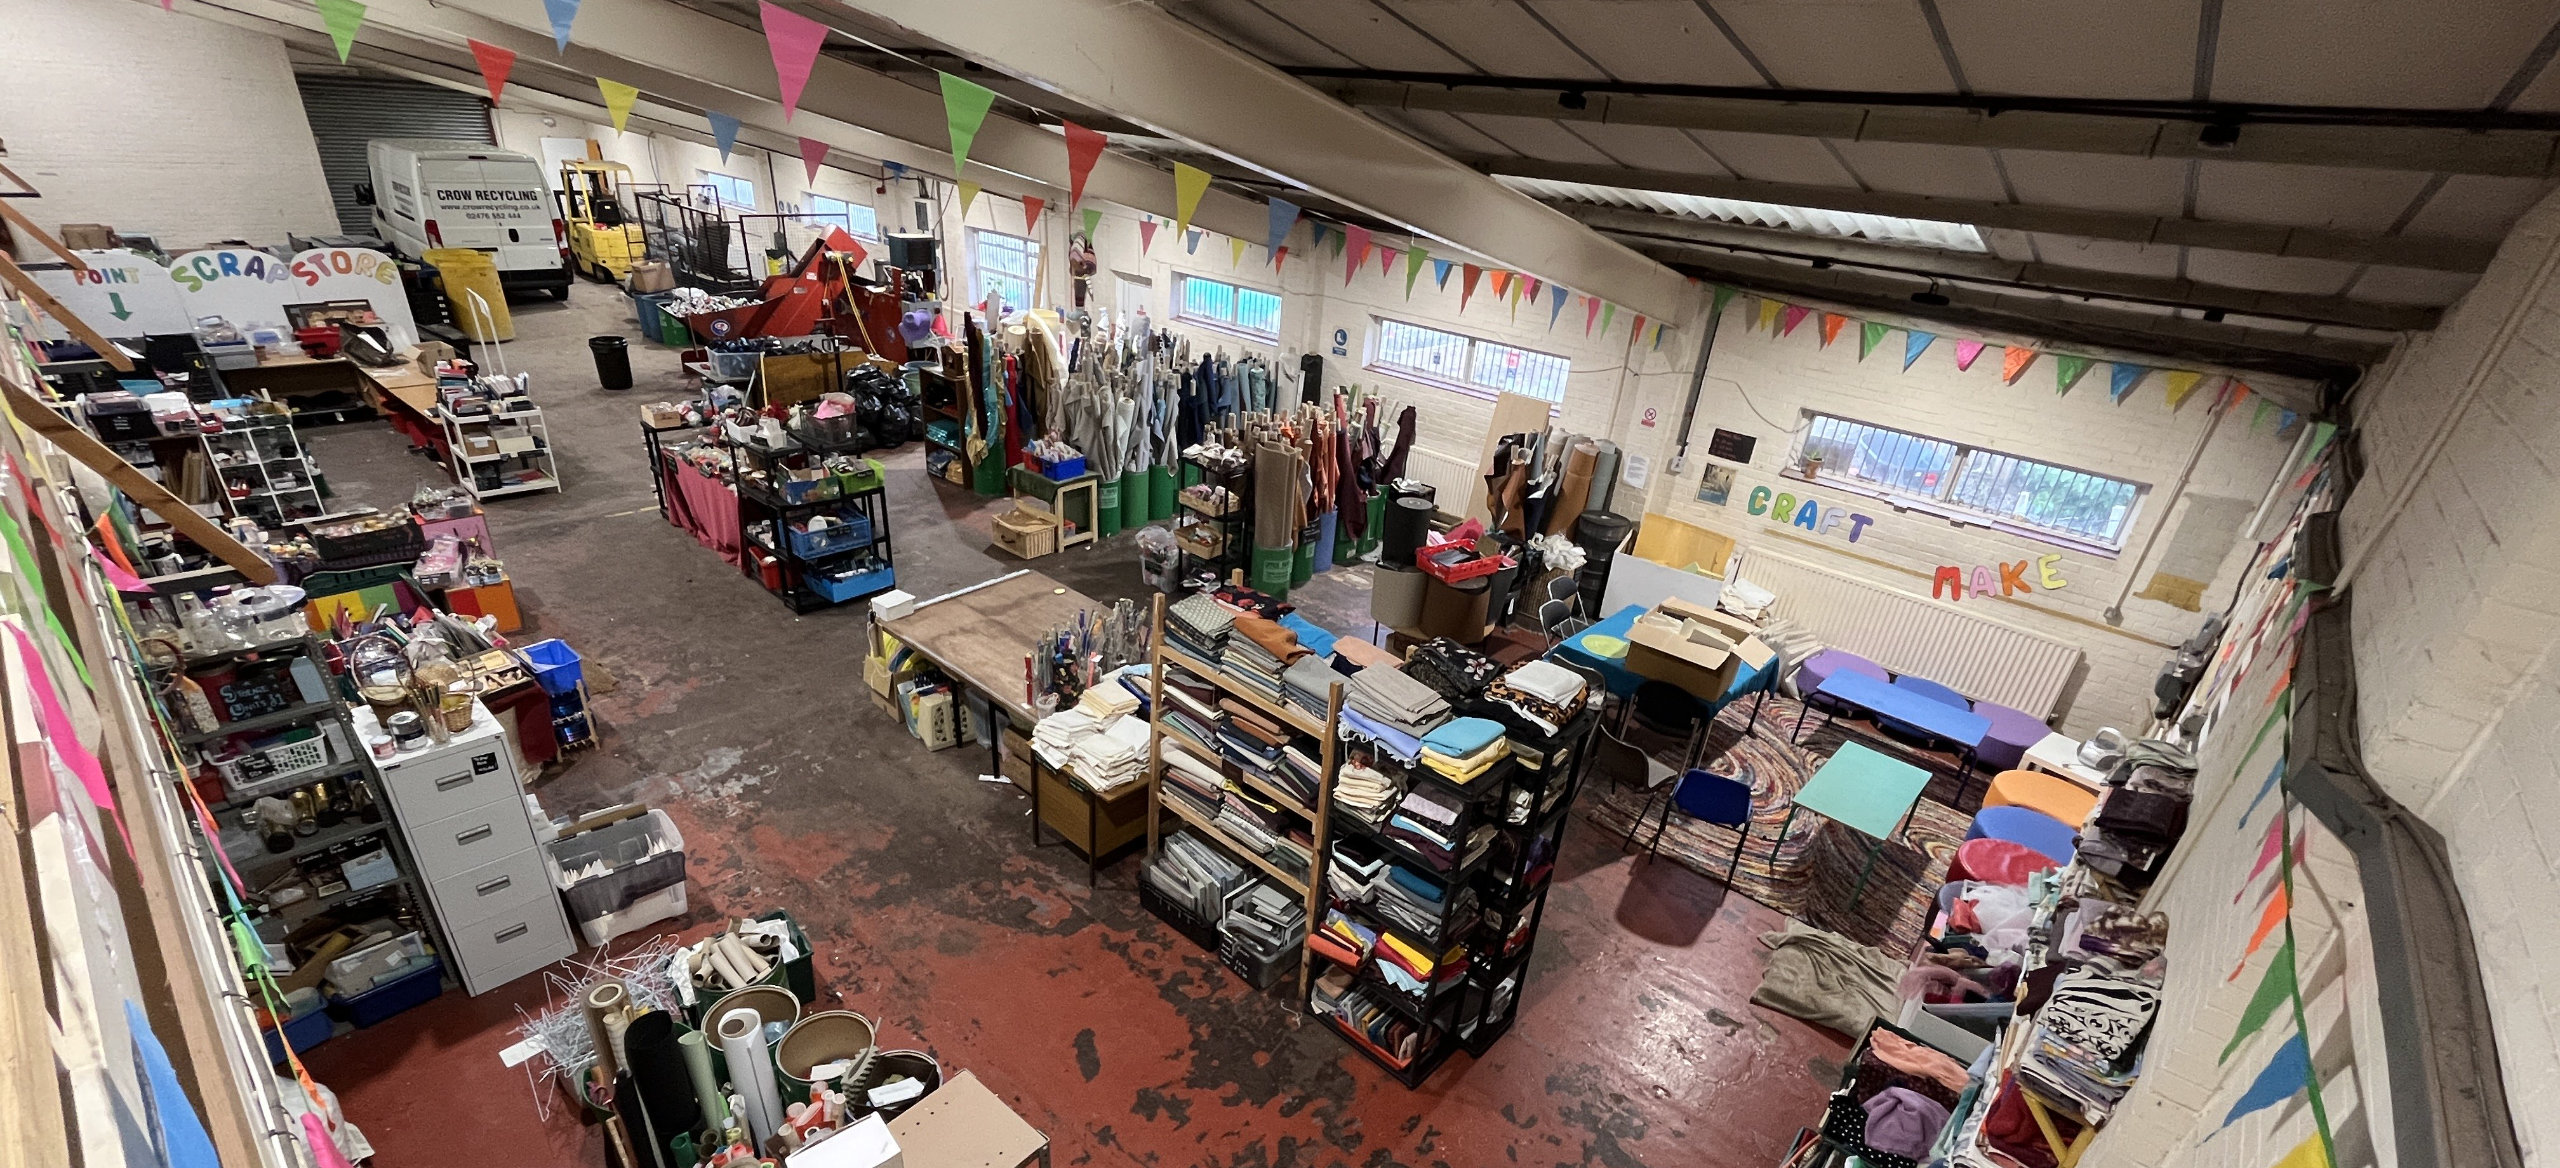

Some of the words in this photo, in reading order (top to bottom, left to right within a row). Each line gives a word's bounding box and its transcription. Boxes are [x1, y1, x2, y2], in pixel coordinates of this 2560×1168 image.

[437, 190, 472, 201] CROW
[475, 190, 538, 201] RECYCLING
[72, 267, 140, 286] POINT
[171, 252, 290, 293] SCRAP
[291, 250, 398, 287] STORE
[1747, 485, 1874, 543] CRAFT
[1932, 553, 2067, 602] MAKE
